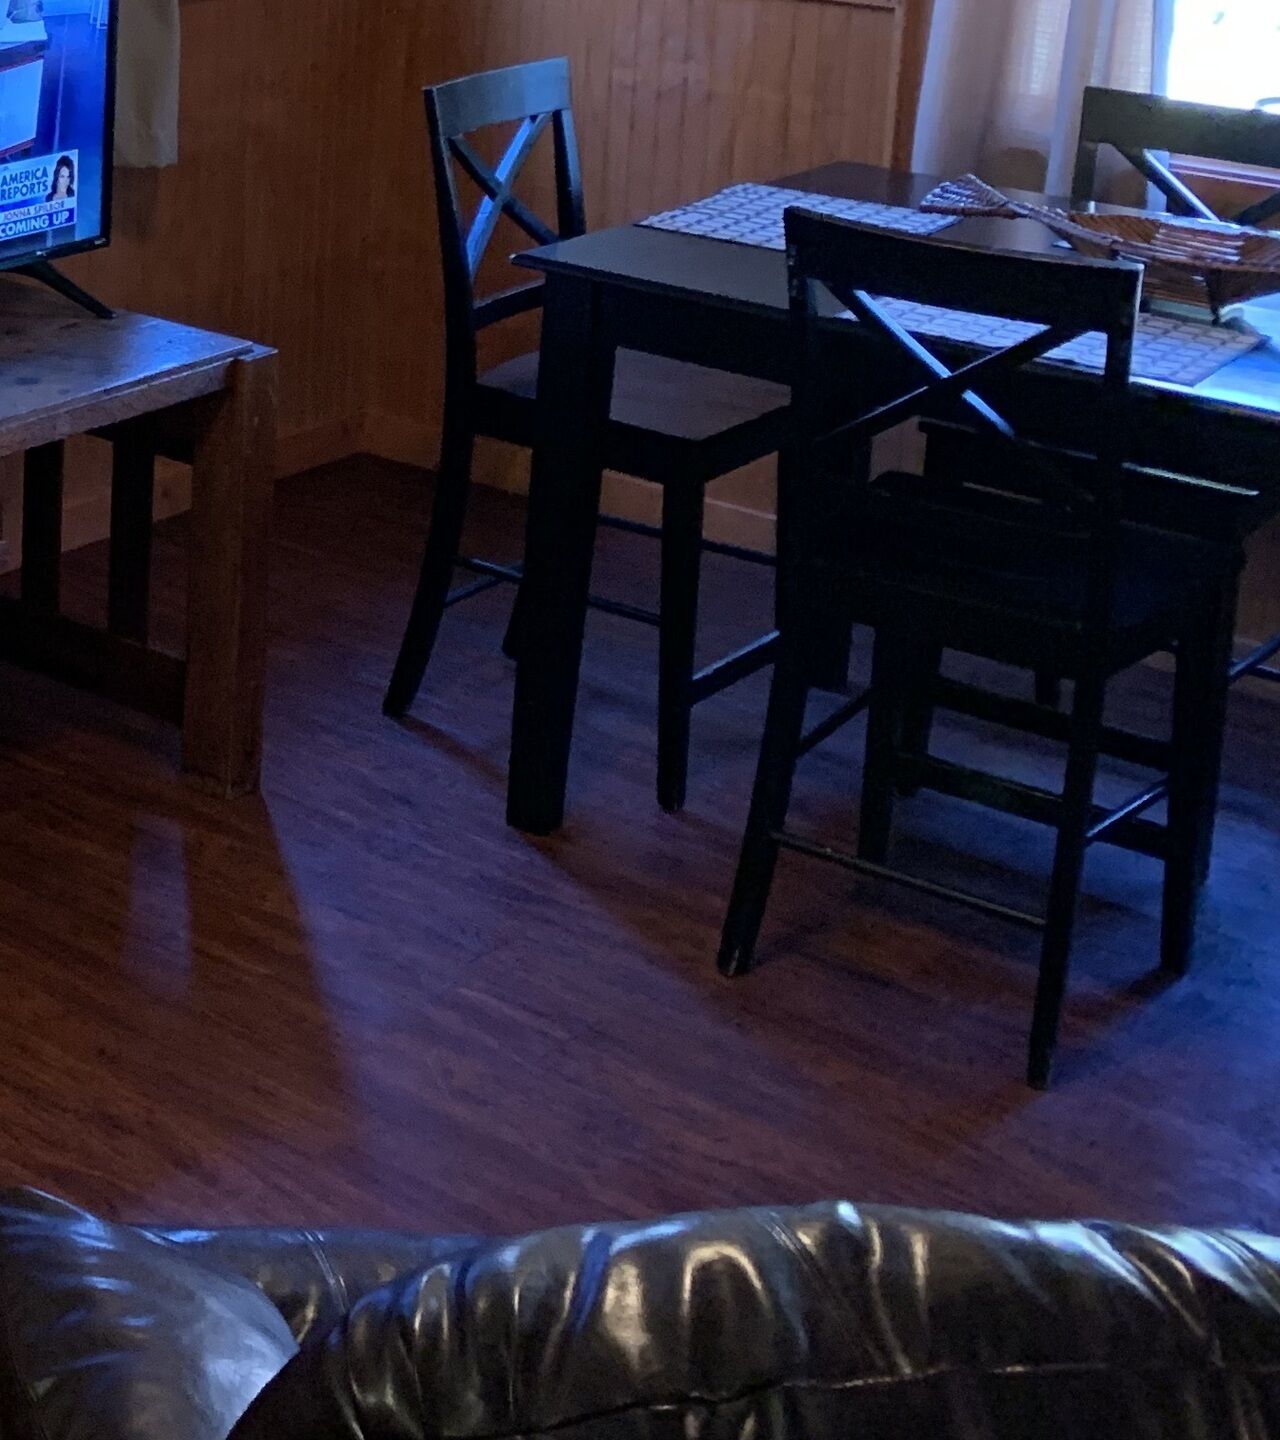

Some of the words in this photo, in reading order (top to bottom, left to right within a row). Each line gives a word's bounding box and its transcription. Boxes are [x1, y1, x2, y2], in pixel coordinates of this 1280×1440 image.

[0, 166, 49, 188] AMERICA
[0, 180, 49, 202] REPORTS
[52, 209, 70, 225] UP
